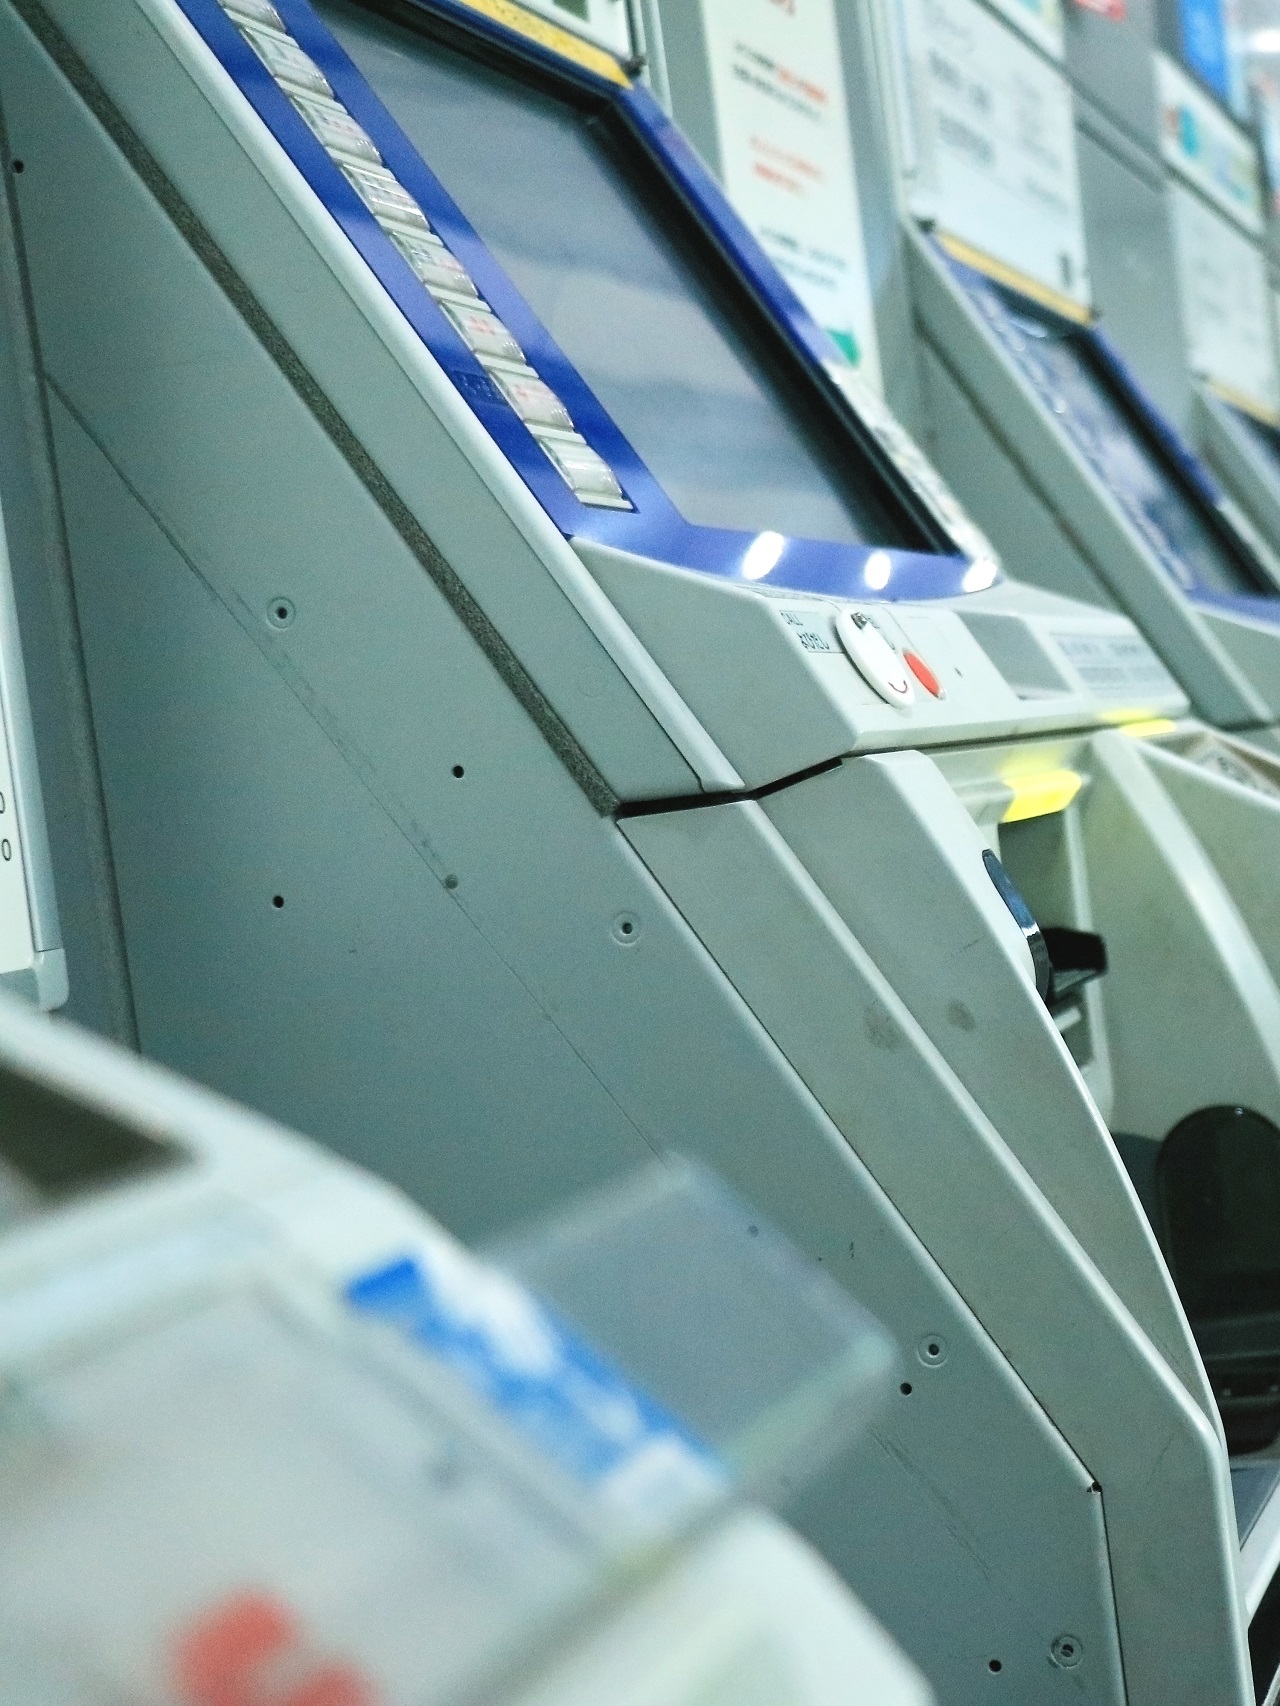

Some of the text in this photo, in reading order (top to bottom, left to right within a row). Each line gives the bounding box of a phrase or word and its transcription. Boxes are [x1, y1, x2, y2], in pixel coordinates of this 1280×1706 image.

[780, 611, 804, 627] CALL
[797, 632, 830, 650] よびだし
